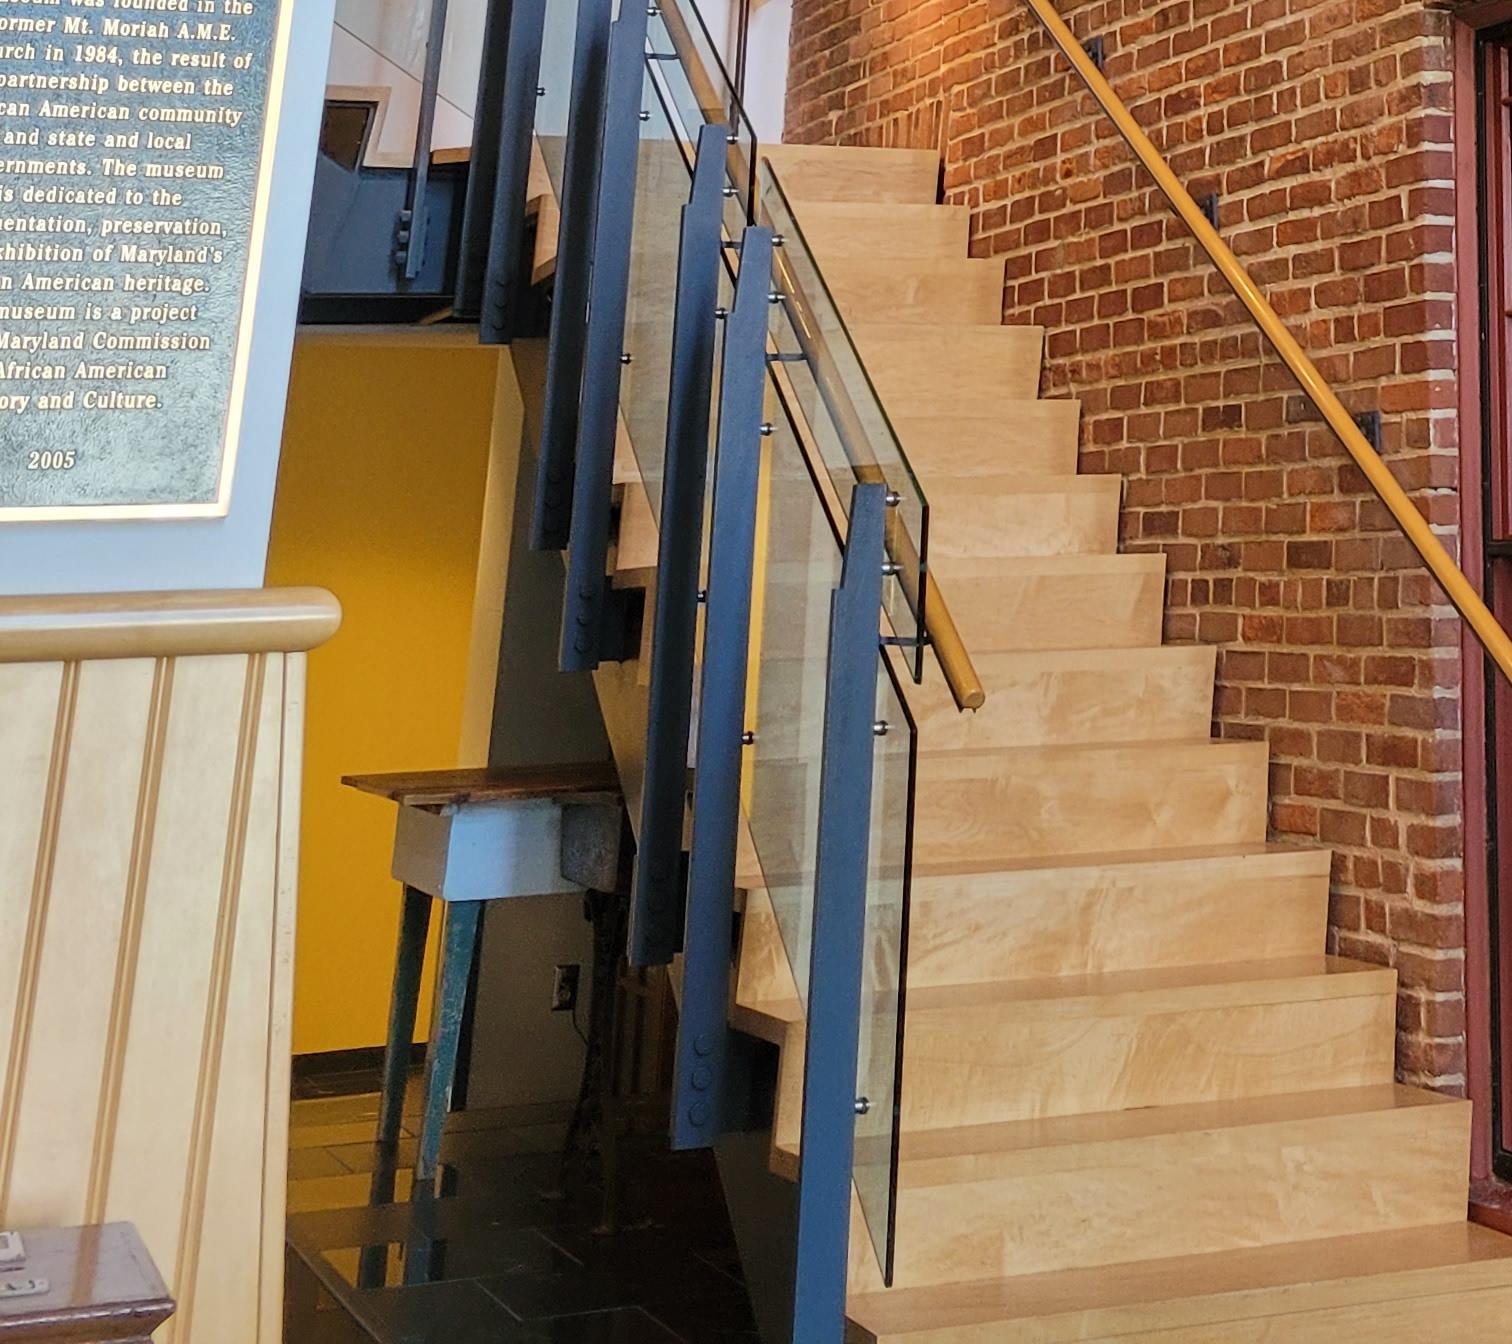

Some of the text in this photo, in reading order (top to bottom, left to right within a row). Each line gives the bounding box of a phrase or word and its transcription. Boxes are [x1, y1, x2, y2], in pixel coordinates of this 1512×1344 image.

[0, 16, 236, 41] ormer Mt. Moriah A.M.E.
[45, 44, 64, 61] in
[74, 45, 124, 66] 1984,
[133, 48, 162, 66] the
[171, 51, 226, 68] result
[233, 52, 253, 69] of
[117, 75, 195, 95] between
[204, 79, 234, 96] the
[38, 100, 130, 120] American
[138, 106, 243, 128] community
[4, 129, 192, 150] and state and local
[0, 159, 224, 179] ernments. The museum
[22, 186, 117, 205] dedicated
[125, 189, 143, 205] to
[152, 189, 182, 206] the
[101, 218, 227, 238] preservation,
[92, 245, 113, 262] of
[120, 244, 223, 267] Maryland's
[21, 273, 114, 291] American
[123, 274, 210, 295] heritage.
[85, 303, 101, 321] is
[110, 307, 122, 321] a
[129, 303, 198, 325] project
[92, 332, 210, 350] Commission
[74, 362, 167, 379] American
[38, 392, 75, 409] and
[83, 391, 163, 409] Culture.
[27, 451, 76, 470] 2005
